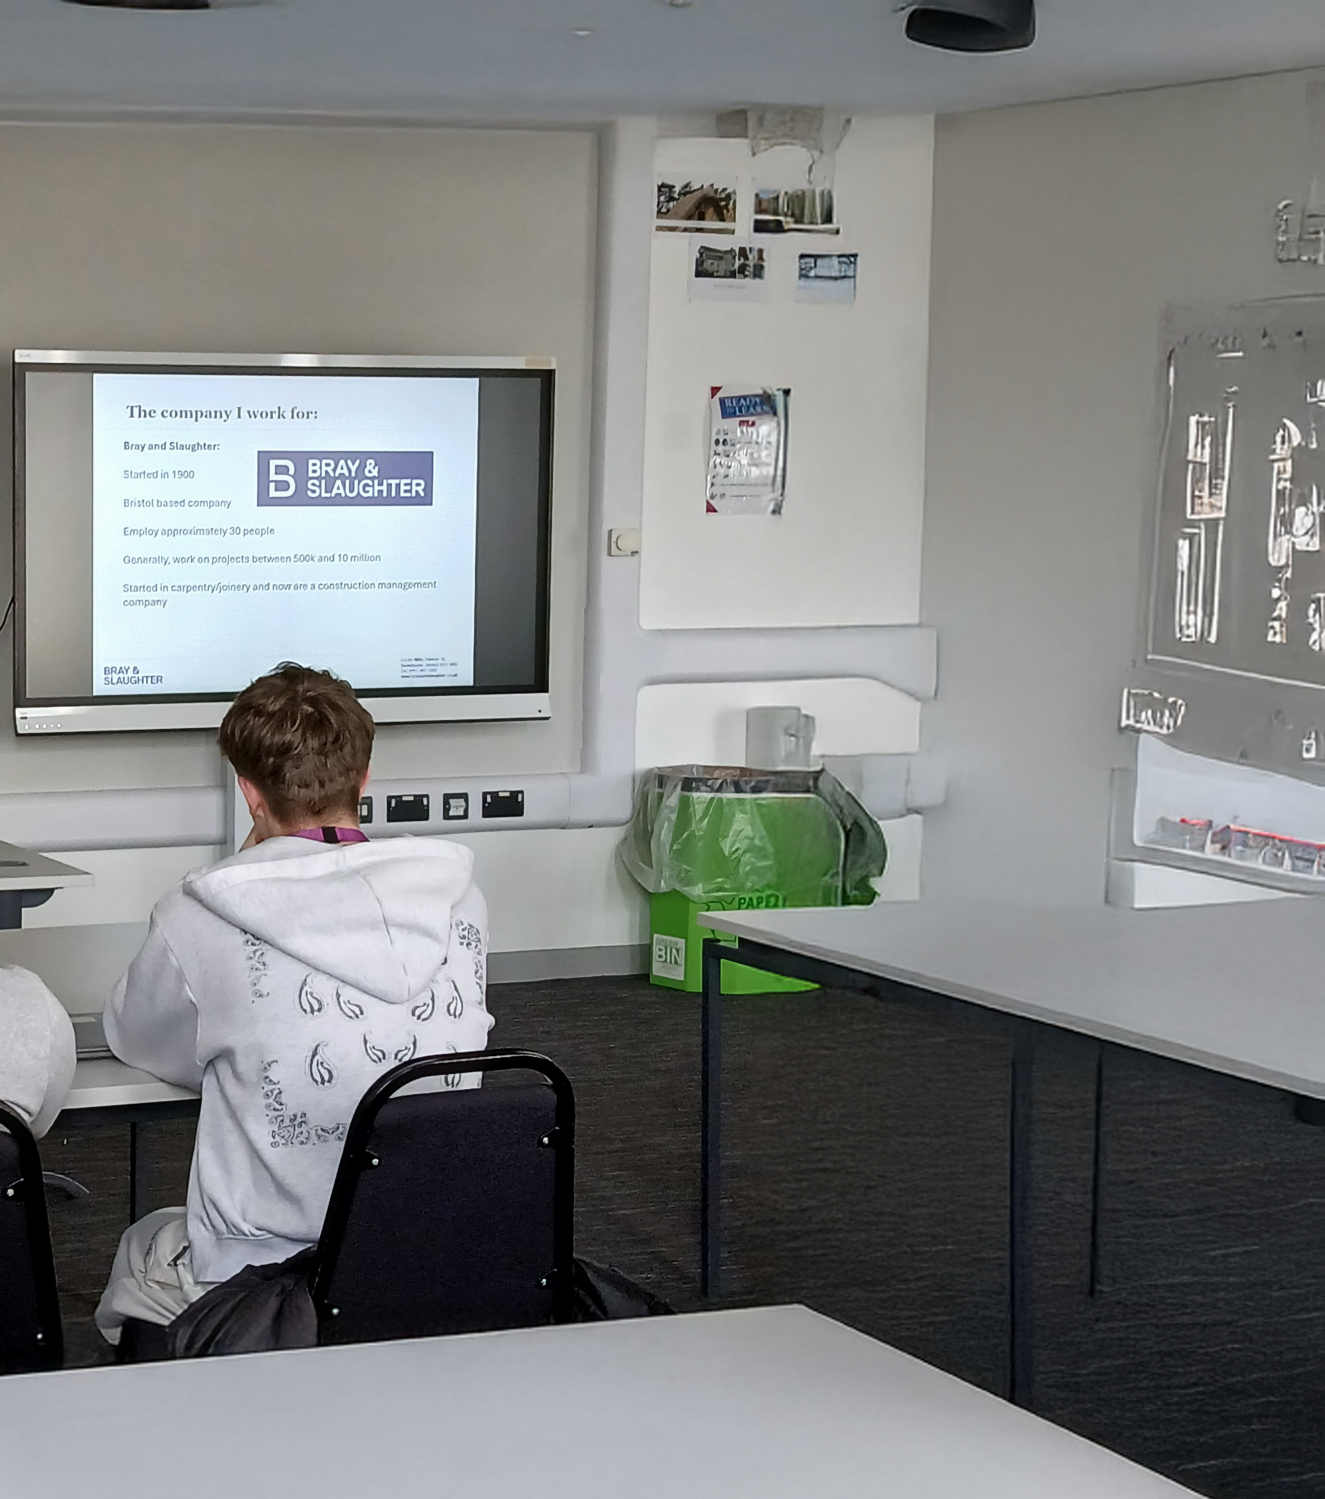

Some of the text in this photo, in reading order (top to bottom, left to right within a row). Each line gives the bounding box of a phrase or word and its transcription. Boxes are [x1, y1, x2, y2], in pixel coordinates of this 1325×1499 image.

[125, 404, 319, 423] The company I work for:
[123, 440, 221, 453] Bray and Slaughter:
[122, 469, 196, 480] Started in 1900
[307, 458, 379, 478] BRAY &
[306, 478, 426, 499] SLAUGHTER
[123, 498, 232, 510] Bristol based company
[122, 525, 276, 539] Employ approximately 30 people
[122, 552, 382, 567] Generally, work on projects between 500k and 10 million
[122, 580, 438, 595] Started in carpentry/joinery and now are a construction management
[122, 598, 168, 610] company
[103, 665, 140, 676] BRAY &
[102, 674, 164, 686] SLAUGHTER
[656, 944, 684, 967] BIN
